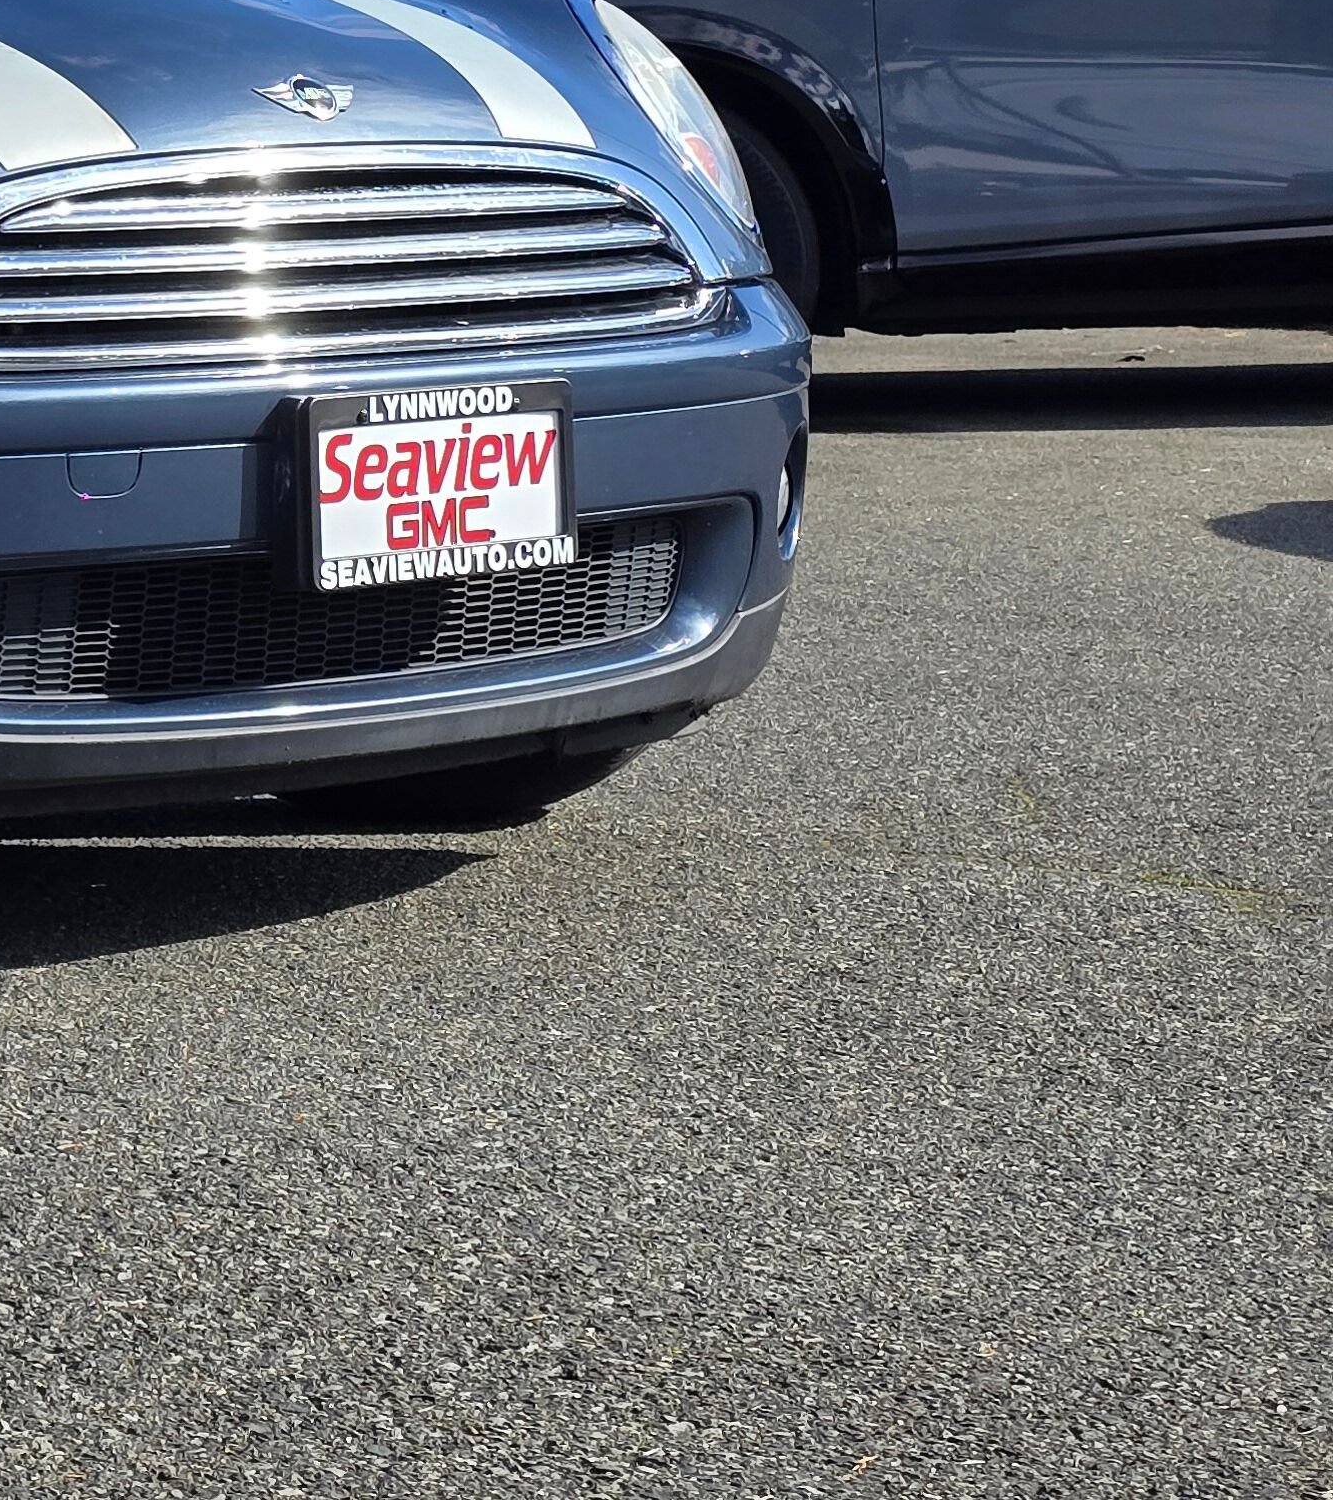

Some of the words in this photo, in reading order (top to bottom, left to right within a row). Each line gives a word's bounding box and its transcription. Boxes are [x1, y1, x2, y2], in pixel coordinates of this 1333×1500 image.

[369, 386, 513, 423] LYNNWOOD
[318, 423, 556, 504] Seaview
[387, 495, 494, 550] GMC
[320, 536, 574, 590] SEAVIEWAUTO.COM
